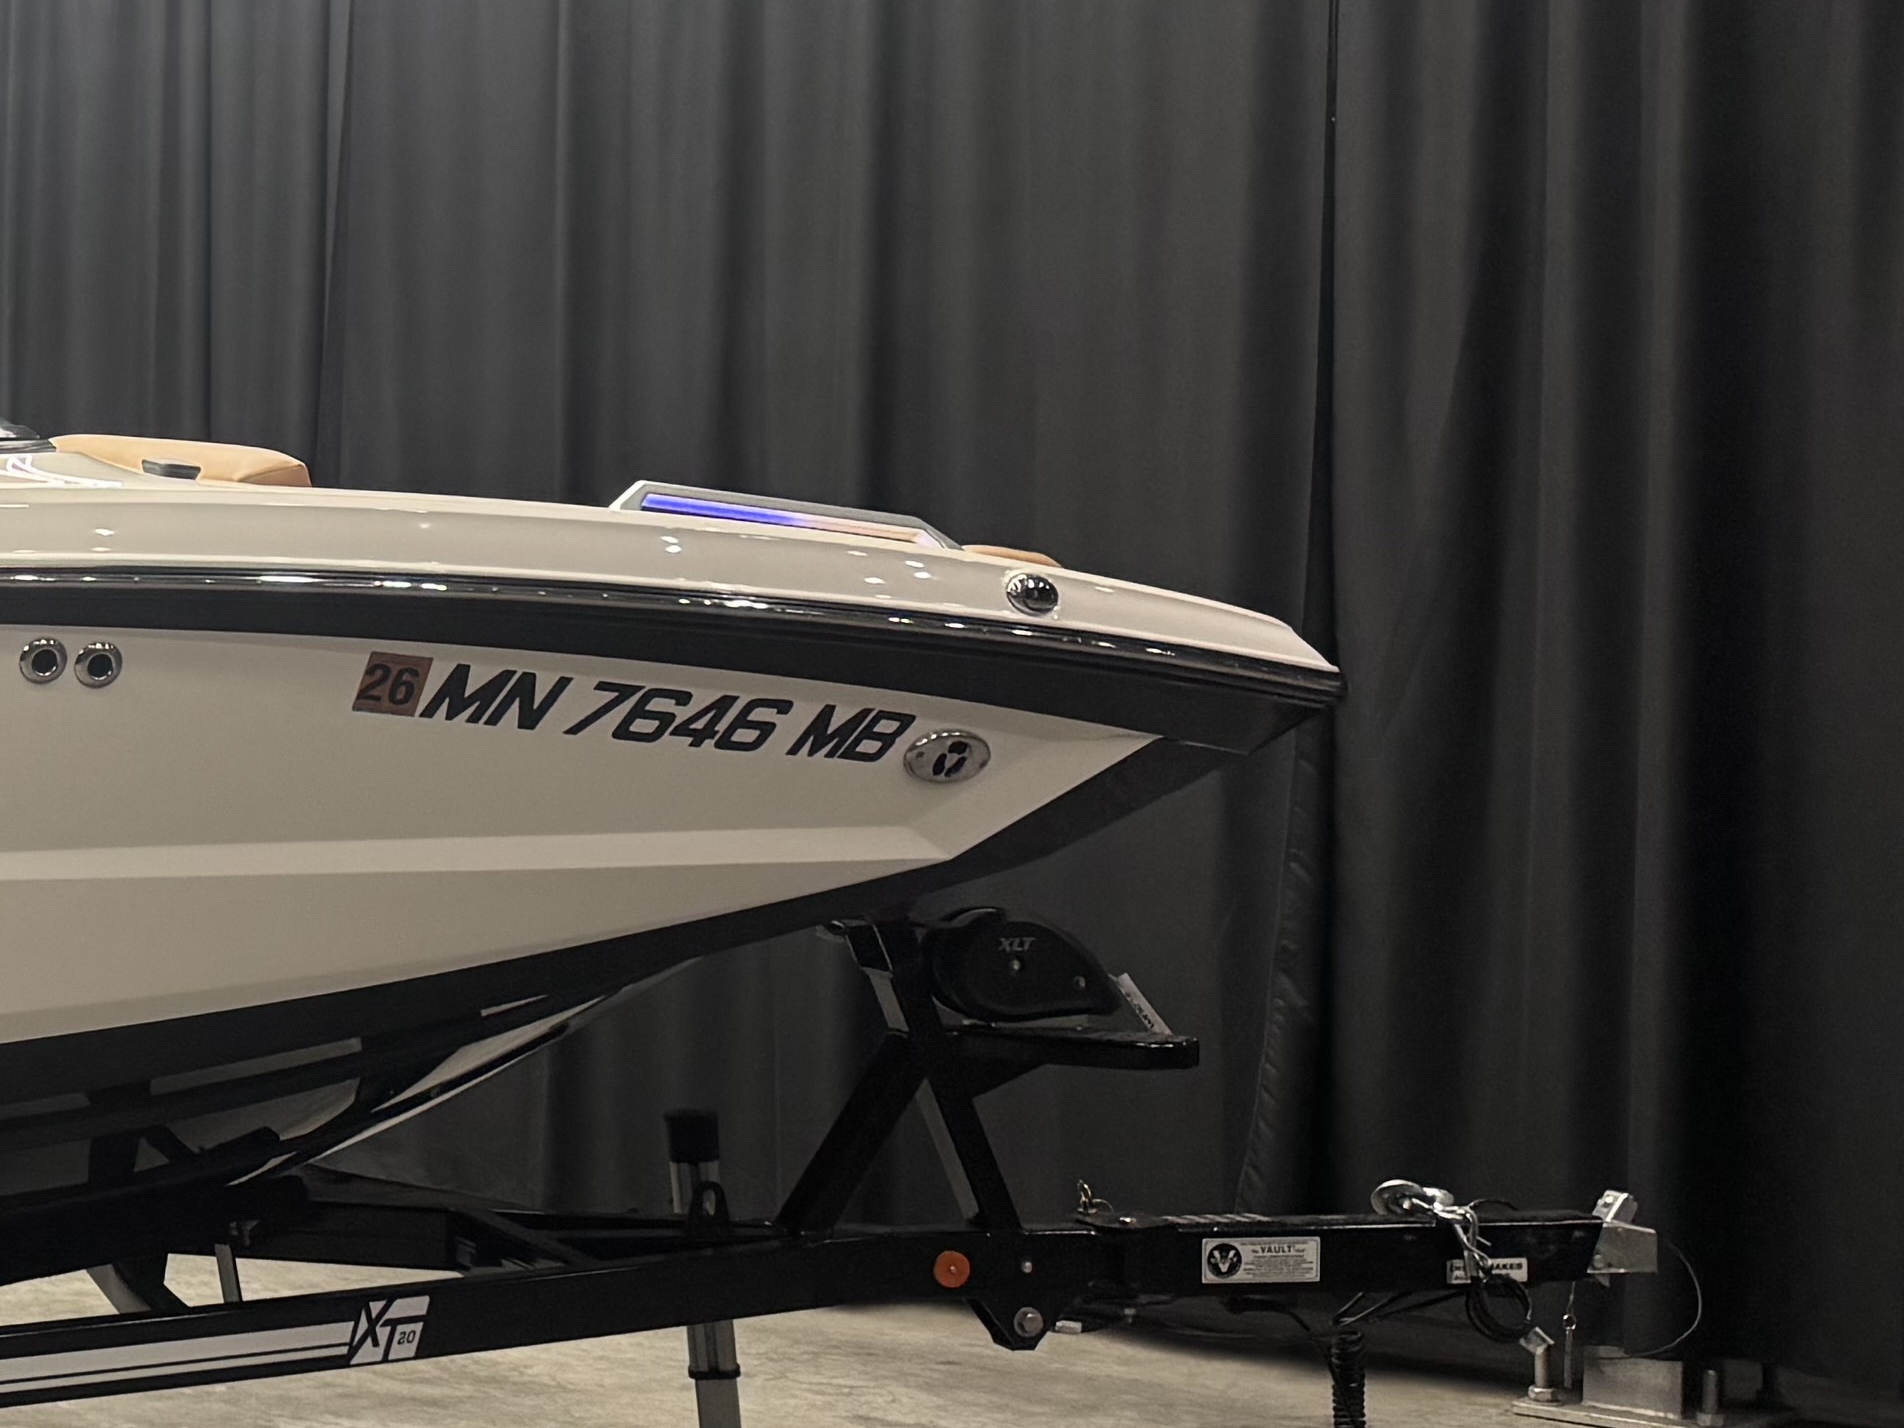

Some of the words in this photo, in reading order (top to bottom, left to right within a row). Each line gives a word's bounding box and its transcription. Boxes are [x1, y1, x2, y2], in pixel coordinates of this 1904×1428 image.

[356, 663, 420, 706] 26
[418, 663, 574, 731] MN
[563, 680, 794, 752] 7646
[785, 703, 917, 763] MB
[998, 937, 1036, 952] XLT
[1260, 1245, 1292, 1254] VAULT
